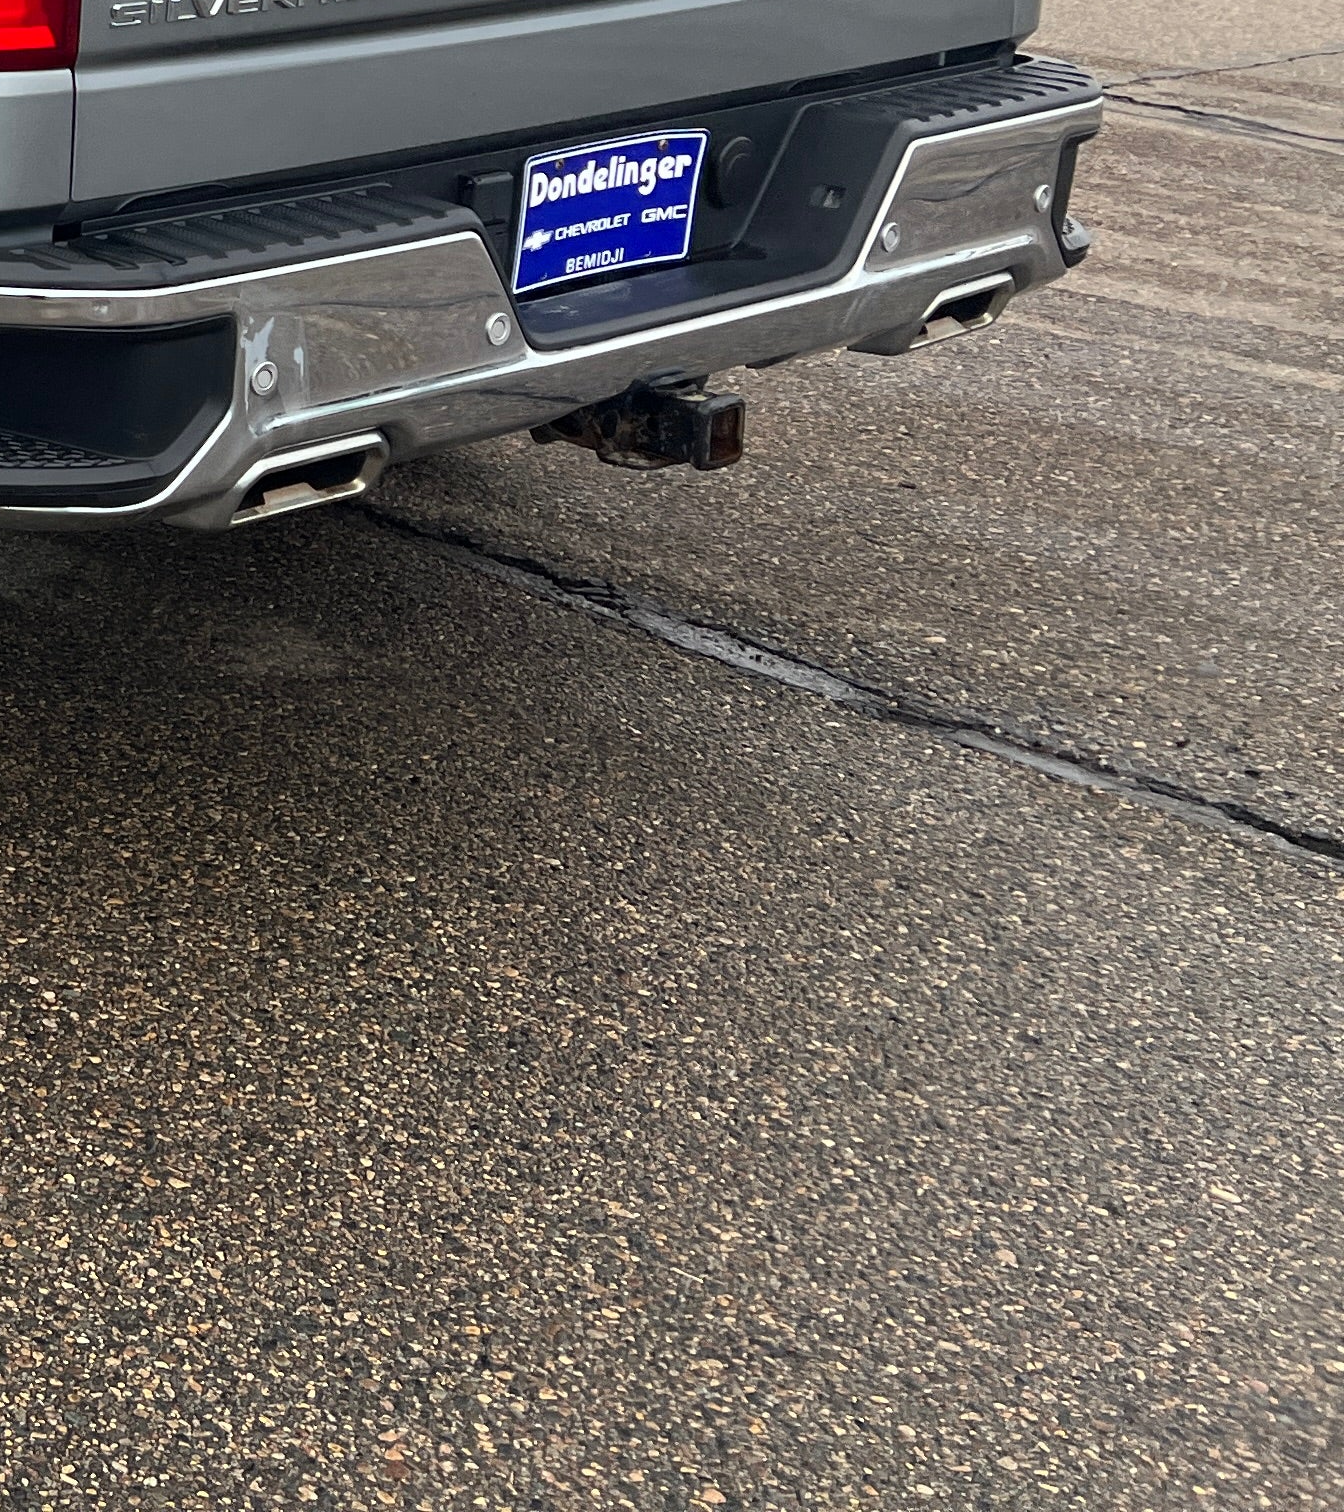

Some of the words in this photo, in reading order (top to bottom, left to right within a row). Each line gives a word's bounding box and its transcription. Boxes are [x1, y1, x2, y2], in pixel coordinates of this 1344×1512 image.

[528, 154, 693, 208] Dondelinger
[554, 212, 632, 241] CHEVROLET
[640, 204, 689, 224] GMC
[565, 247, 625, 274] BEMIDJI
